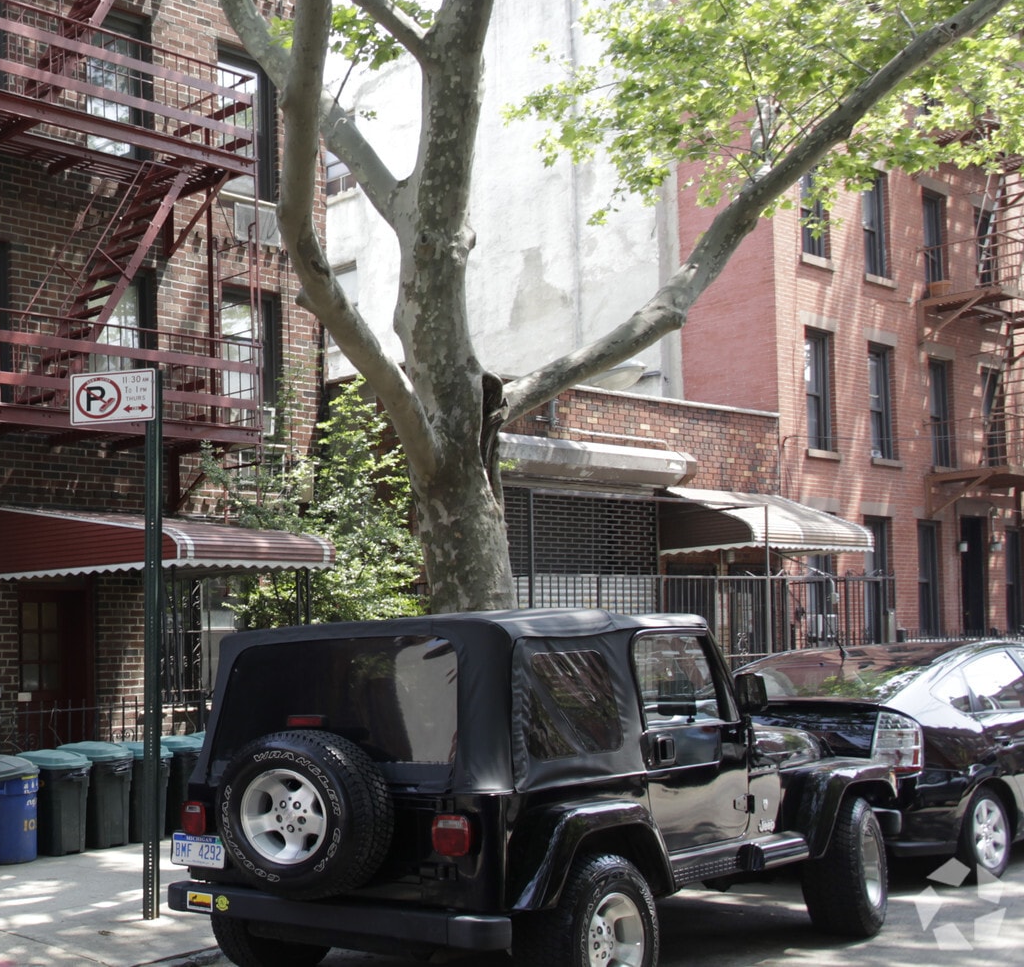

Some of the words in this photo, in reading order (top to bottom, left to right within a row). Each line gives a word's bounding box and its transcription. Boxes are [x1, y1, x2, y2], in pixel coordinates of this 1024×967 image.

[253, 750, 341, 817] WRANGLER
[175, 842, 192, 858] BMF
[198, 844, 222, 862] 4292
[186, 835, 213, 843] MICHIGAN
[221, 784, 280, 882] GOODYEAR
